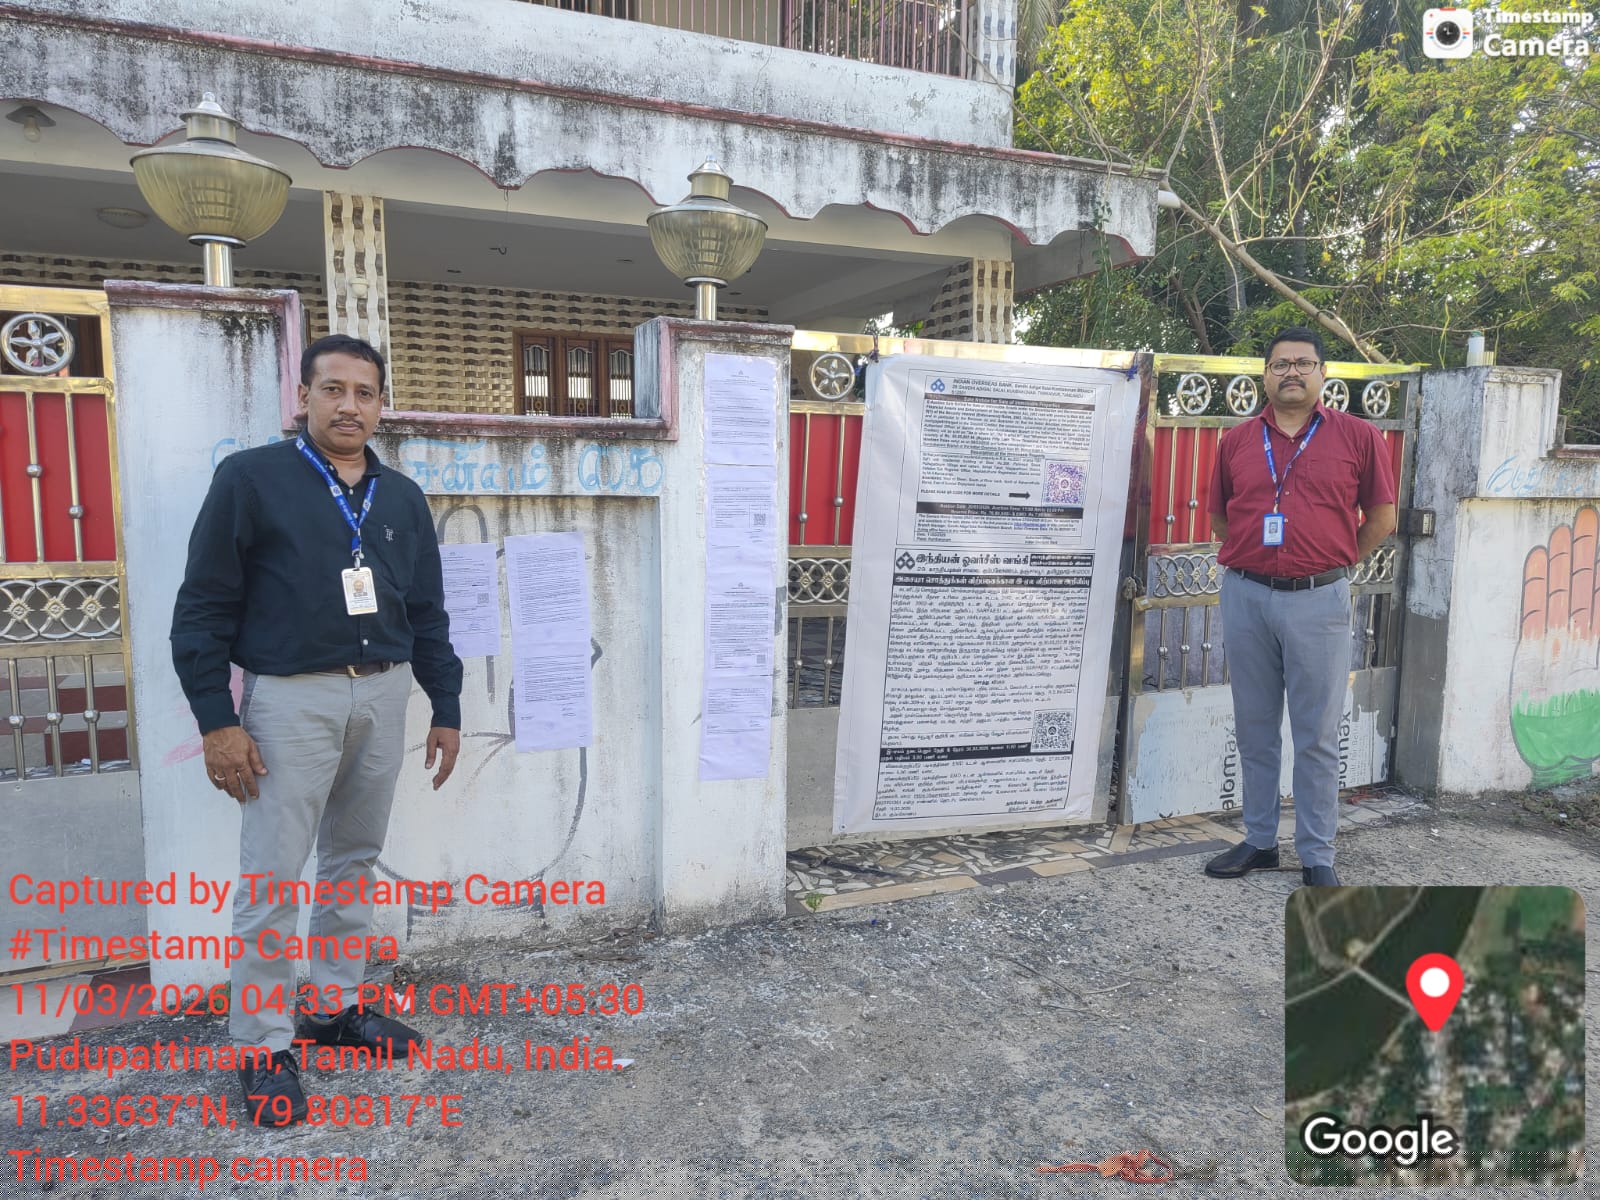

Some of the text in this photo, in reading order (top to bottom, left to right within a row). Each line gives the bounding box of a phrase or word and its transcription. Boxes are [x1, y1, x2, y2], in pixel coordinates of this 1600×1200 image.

[916, 553, 1028, 566] இந்தியன் ஓவர்சீஸ் வங்கி
